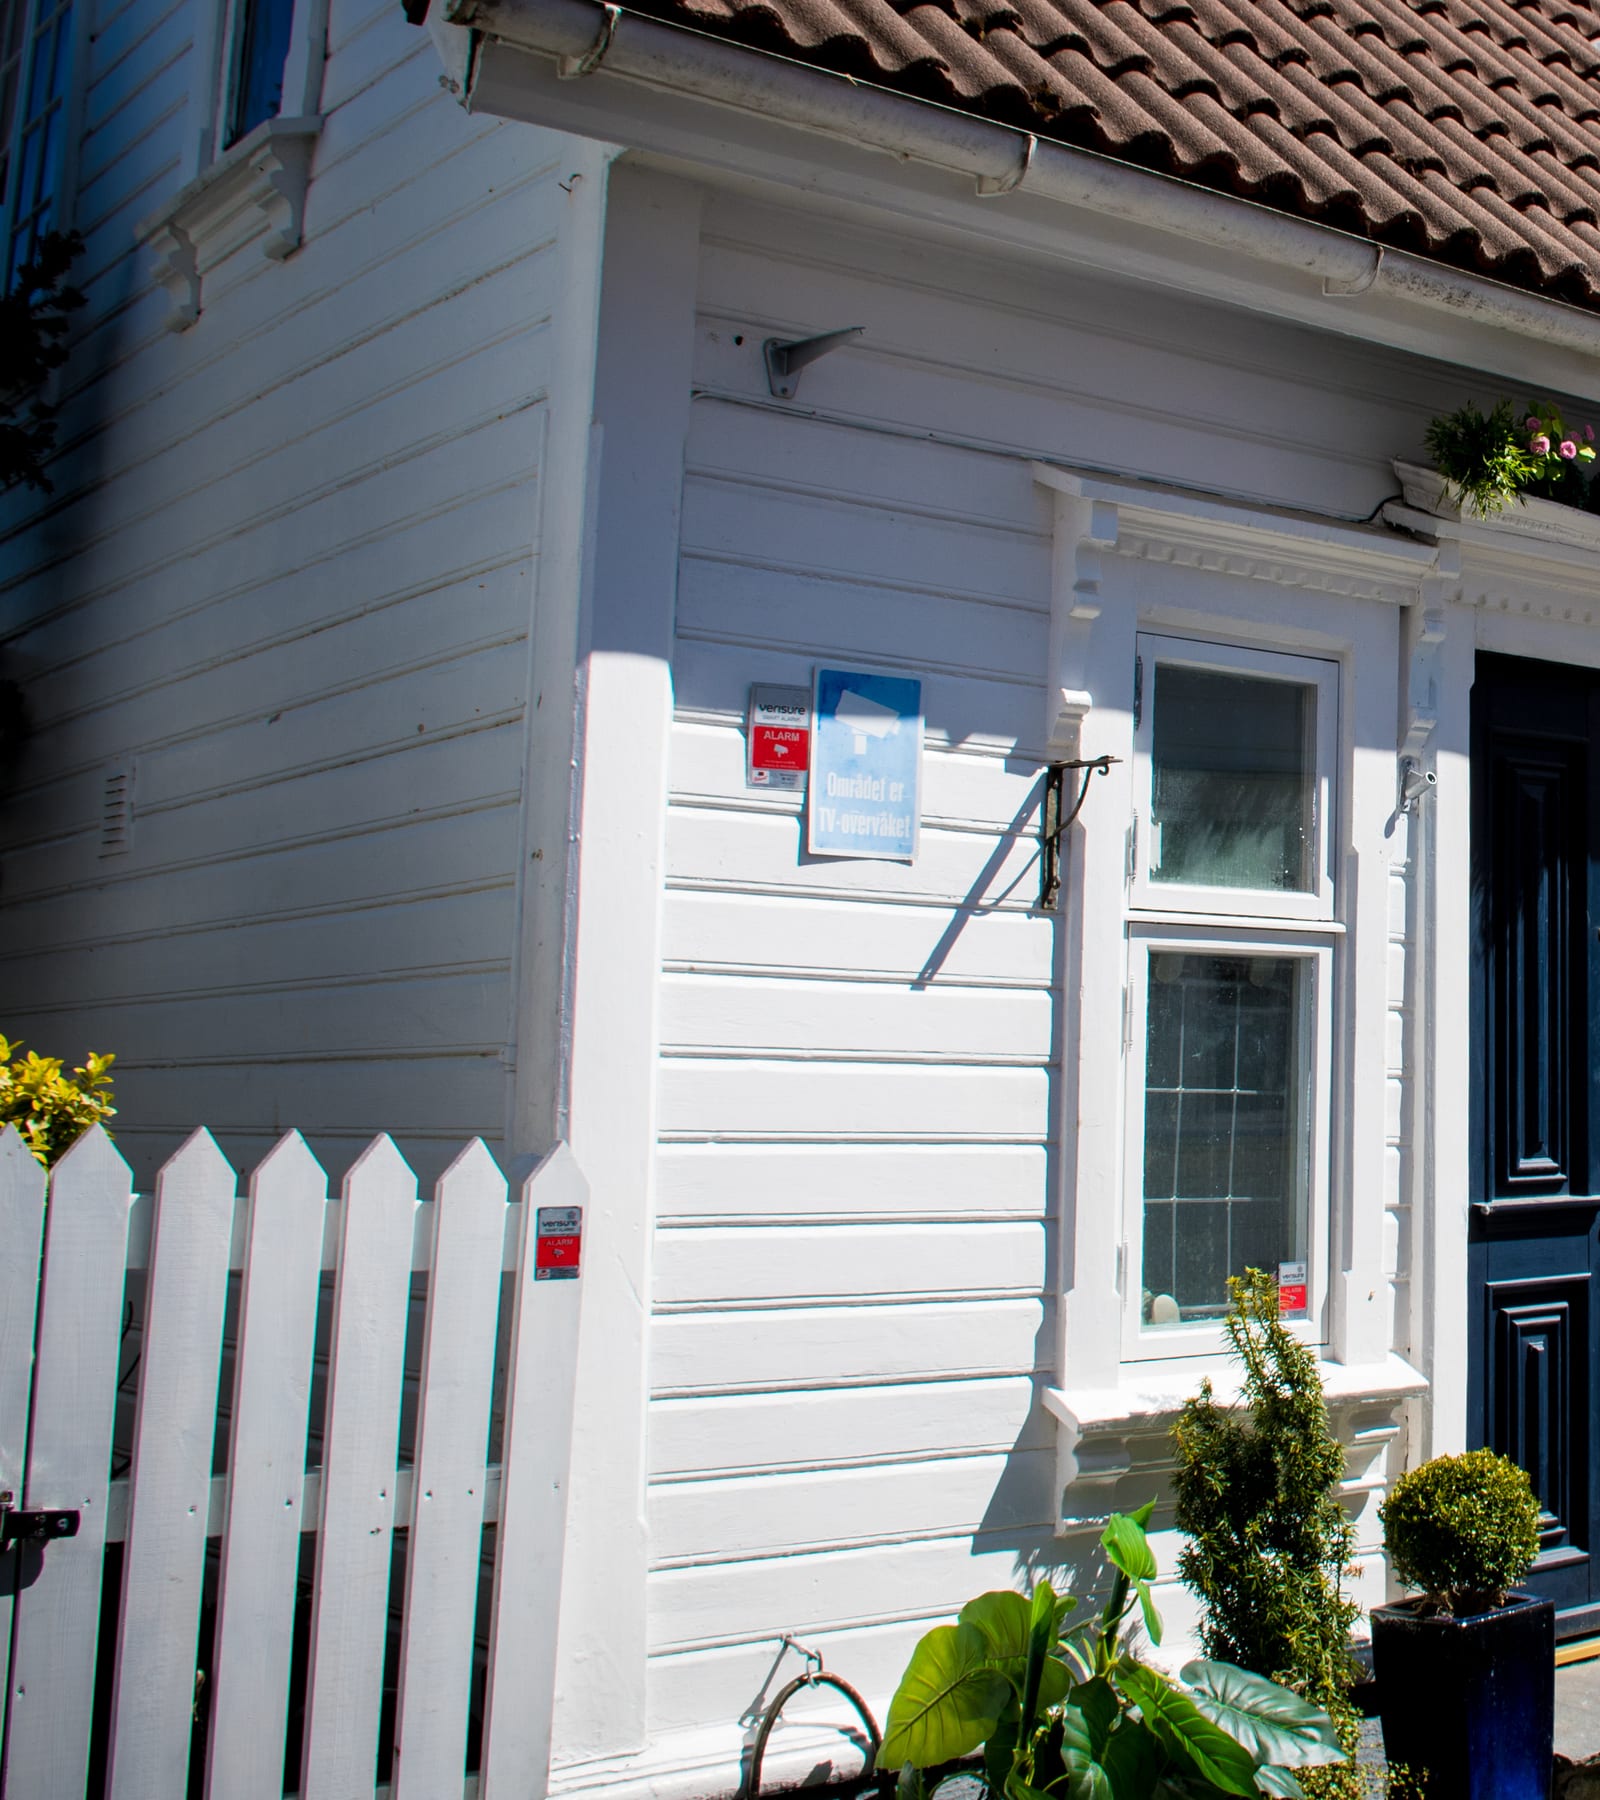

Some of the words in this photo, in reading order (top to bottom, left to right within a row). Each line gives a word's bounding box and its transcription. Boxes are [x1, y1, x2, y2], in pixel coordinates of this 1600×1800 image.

[759, 703, 806, 715] verisure
[764, 730, 800, 742] ALARM
[827, 772, 886, 801] Området
[890, 782, 904, 802] er
[819, 807, 910, 838] TV-overvåket
